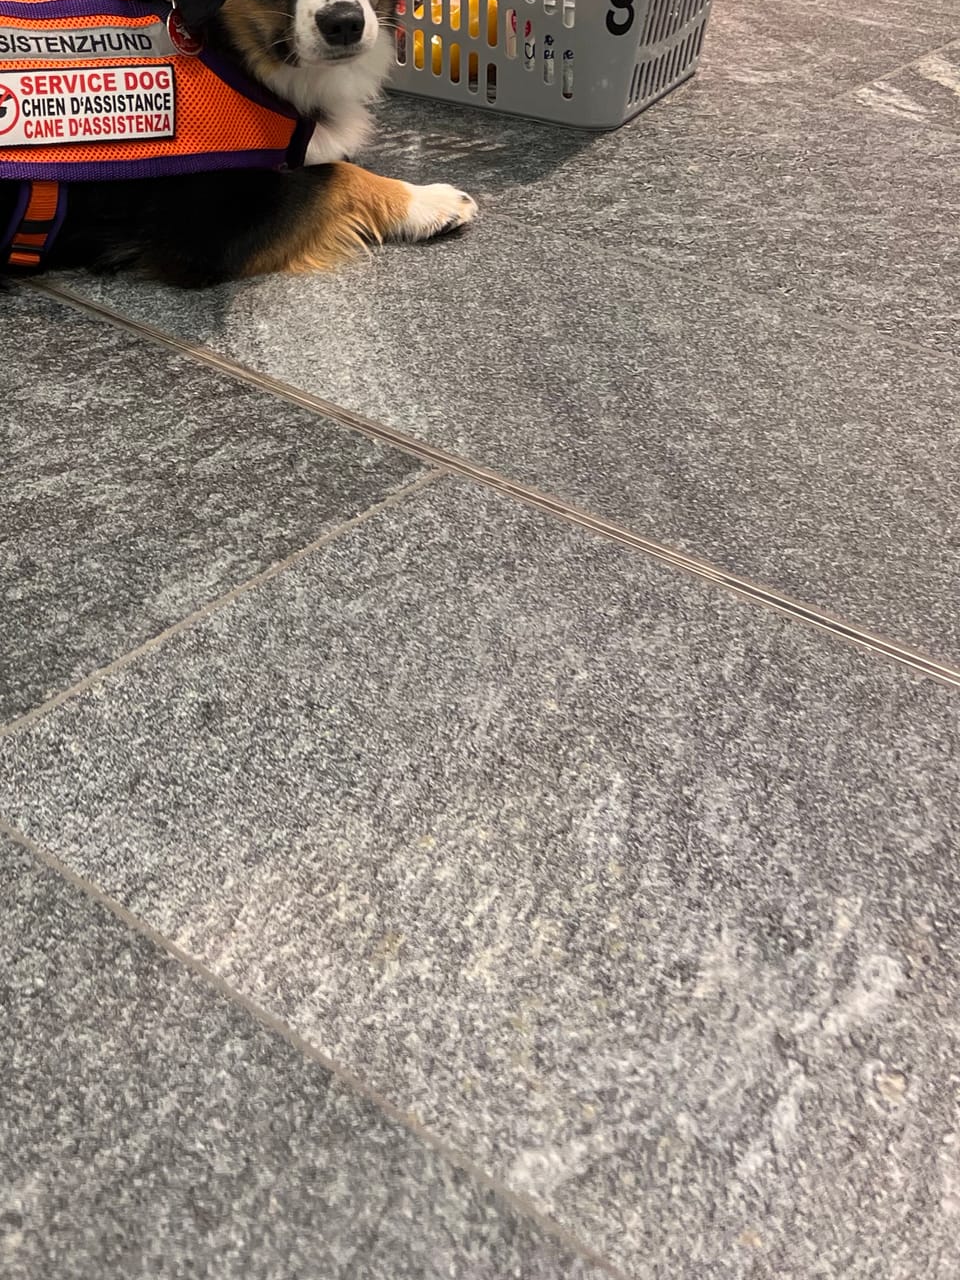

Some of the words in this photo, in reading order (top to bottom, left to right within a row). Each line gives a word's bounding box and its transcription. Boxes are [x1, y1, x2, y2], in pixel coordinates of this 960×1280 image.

[20, 73, 117, 95] SERVICE
[124, 70, 171, 91] DOG
[21, 97, 66, 117] CHIEN
[71, 93, 172, 115] D'ASSISTANCE
[24, 120, 65, 139] CANE
[69, 113, 171, 137] D'ASSISTENZA
